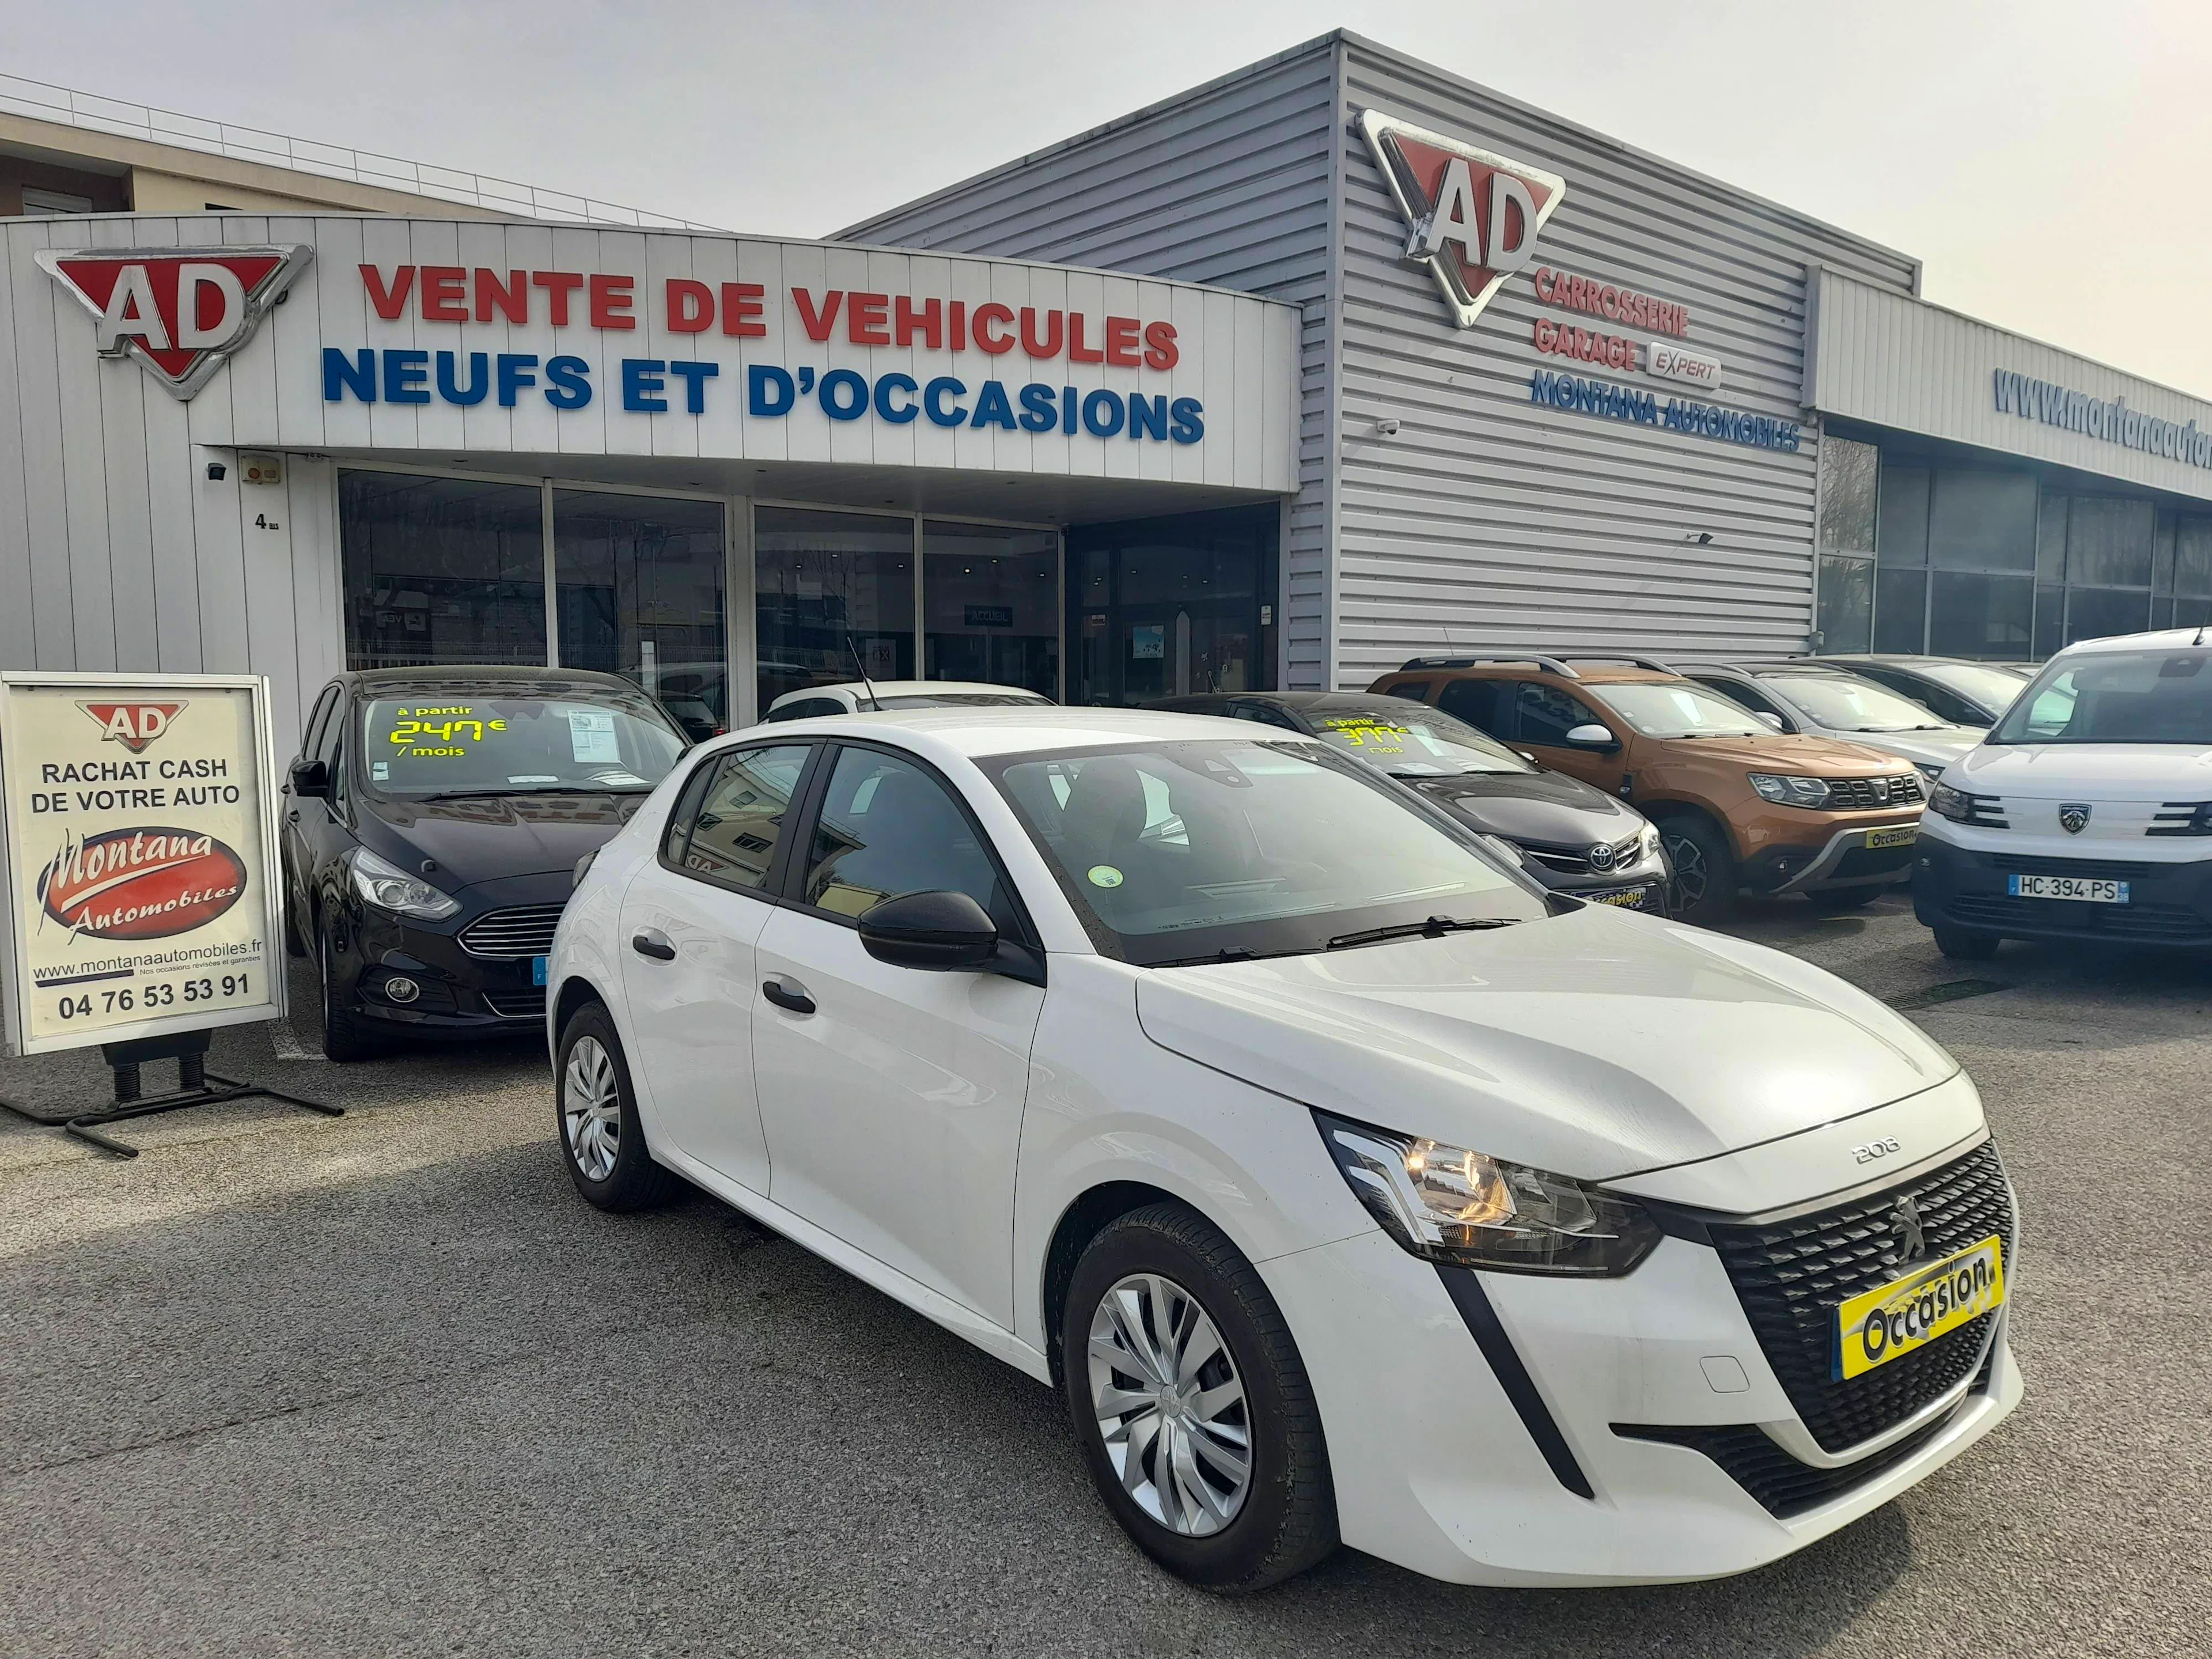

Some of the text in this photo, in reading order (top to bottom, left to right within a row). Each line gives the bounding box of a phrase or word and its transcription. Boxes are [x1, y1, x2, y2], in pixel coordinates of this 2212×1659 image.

[1423, 157, 1538, 273] AD
[99, 263, 247, 351] AD
[358, 264, 1179, 370] VENTE DE VEHICULES
[1535, 266, 1688, 338] CARROSSERIE
[1534, 317, 1637, 372] GARAGE
[1656, 350, 1716, 381] EXPERT
[323, 349, 1205, 444] NEUFS ET D'OCCASIONS
[1532, 369, 1801, 452] MONTANA AUTOMOBILES
[255, 514, 266, 529] 4
[104, 707, 167, 739] AD
[397, 706, 473, 717] à partir
[412, 746, 465, 756] mois
[42, 759, 227, 783] RACHAT CASH
[32, 785, 239, 813] DE VOTRE AUTO
[68, 884, 237, 945] Automobiles
[2118, 892, 2129, 902] 38
[33, 939, 262, 979] www.montanaautomobiles.fr
[156, 964, 191, 974] occasions
[230, 956, 260, 965] garanties
[59, 974, 248, 1019] 04 76 53 53 91
[1851, 1135, 1901, 1165] 208
